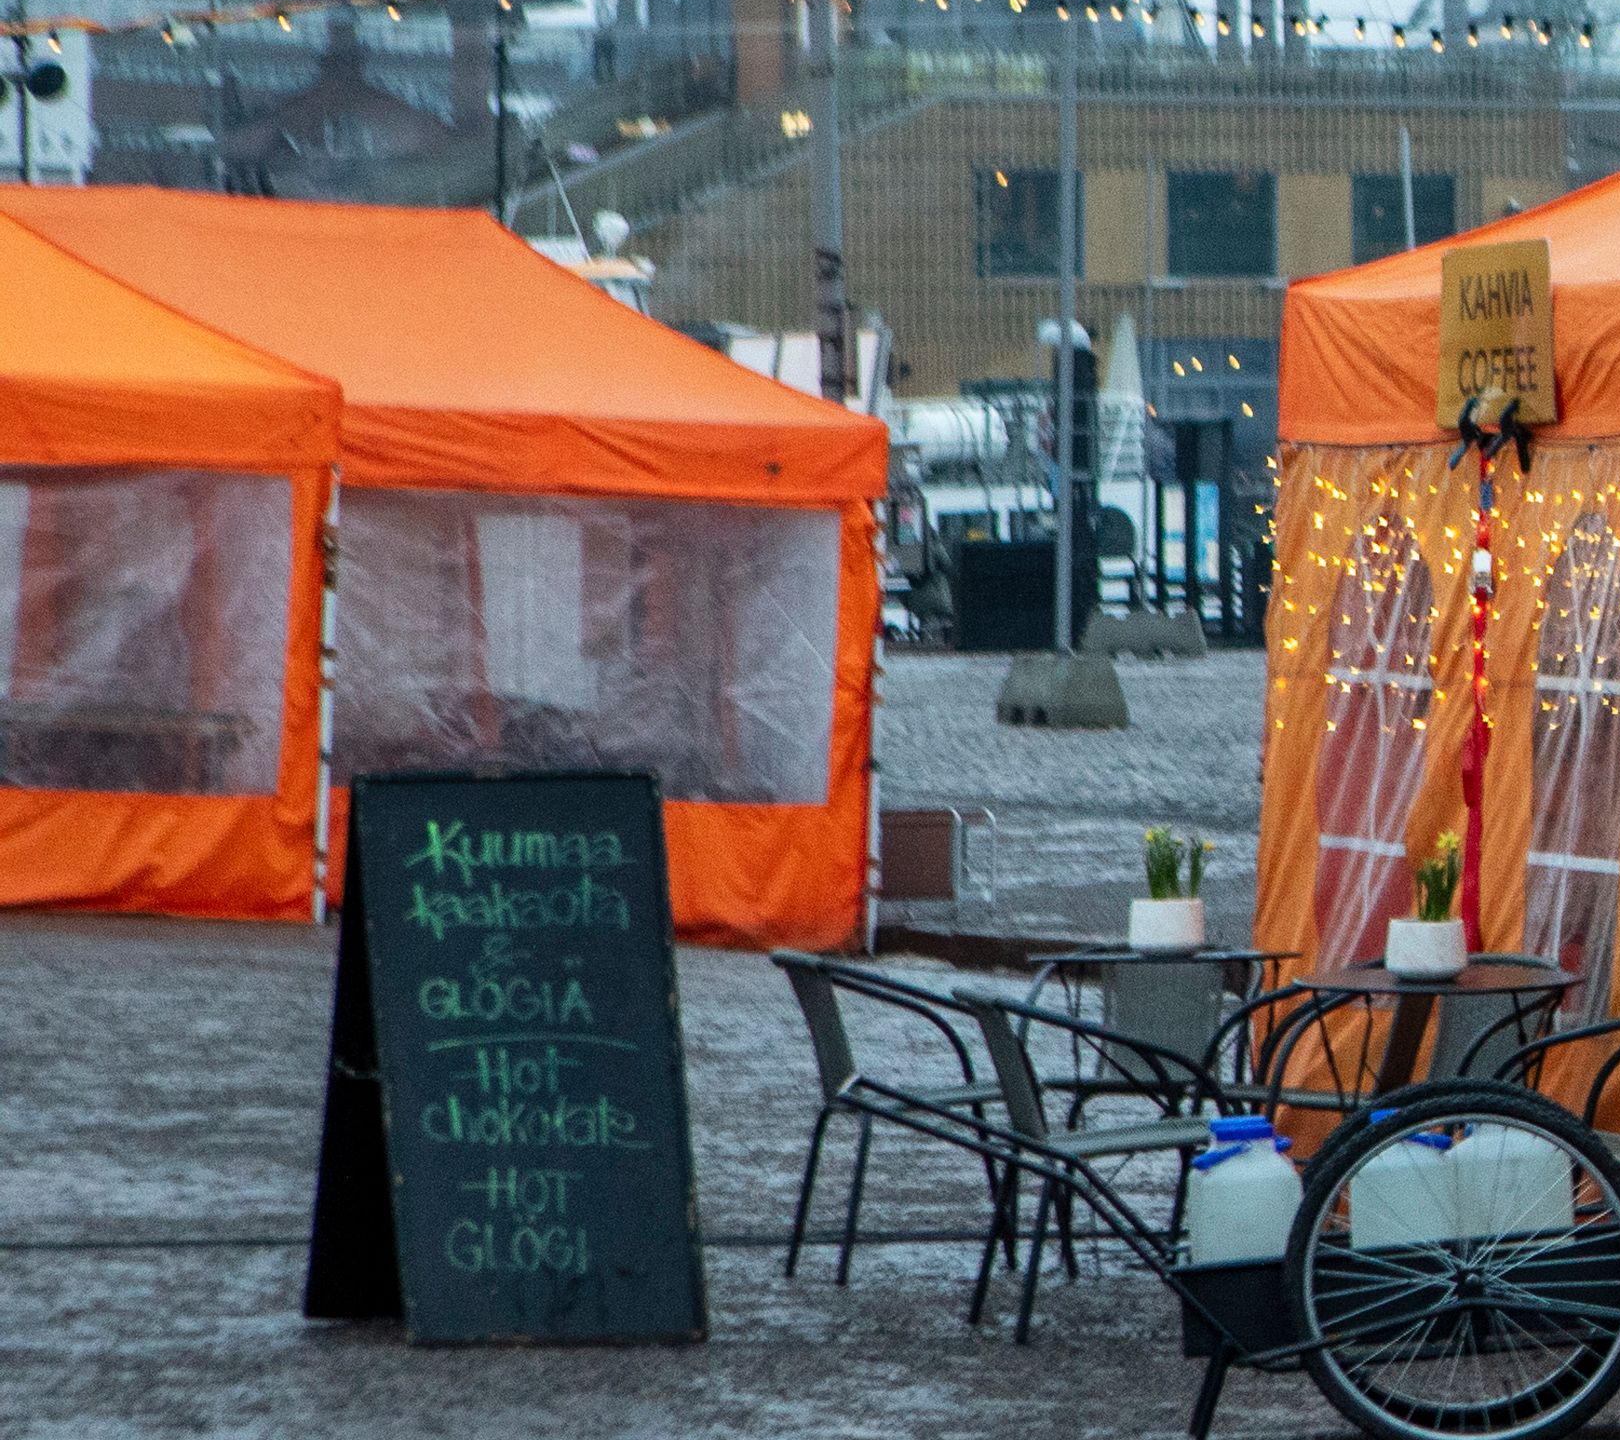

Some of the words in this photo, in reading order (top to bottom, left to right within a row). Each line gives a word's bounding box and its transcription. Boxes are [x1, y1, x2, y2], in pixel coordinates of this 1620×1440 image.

[1459, 268, 1534, 320] KAHVIA
[1458, 345, 1537, 397] COFFEE
[403, 818, 630, 887] Kuumaa
